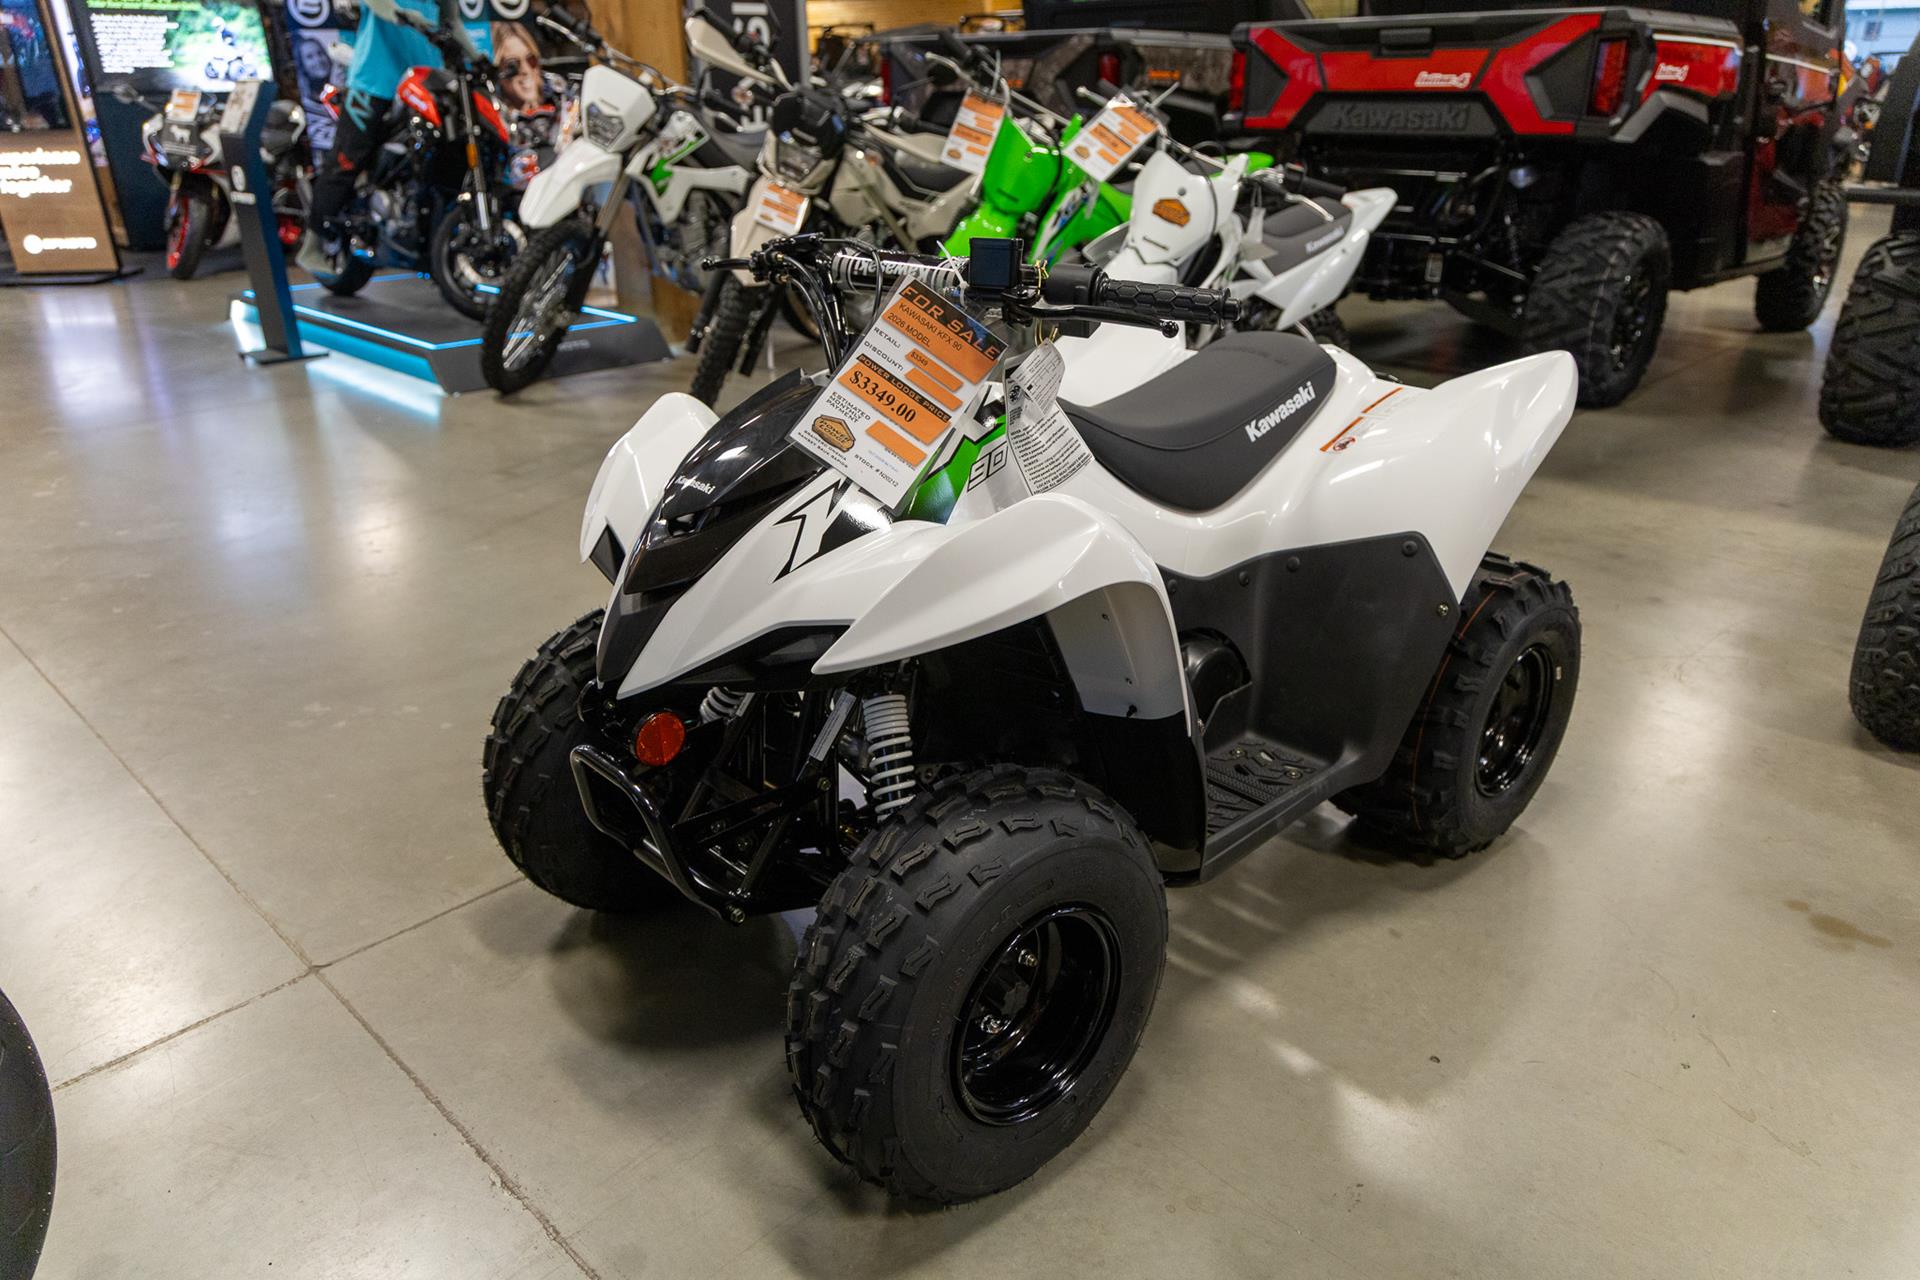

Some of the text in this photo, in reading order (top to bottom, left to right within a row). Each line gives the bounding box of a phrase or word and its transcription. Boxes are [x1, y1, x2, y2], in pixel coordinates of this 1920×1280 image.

[1333, 102, 1470, 131] Kawasaki
[887, 312, 932, 348] 2026 MODEL
[899, 303, 963, 352] KAWASAKI KFX 90
[900, 286, 1000, 360] FOR SALE
[826, 399, 859, 423] PAYMENT
[832, 391, 871, 421] ESTIMATED
[849, 370, 916, 423] $3349.00
[859, 355, 950, 422] POWER LODGE PRICE
[1244, 381, 1317, 443] Kawasaki
[967, 440, 1009, 492] 90
